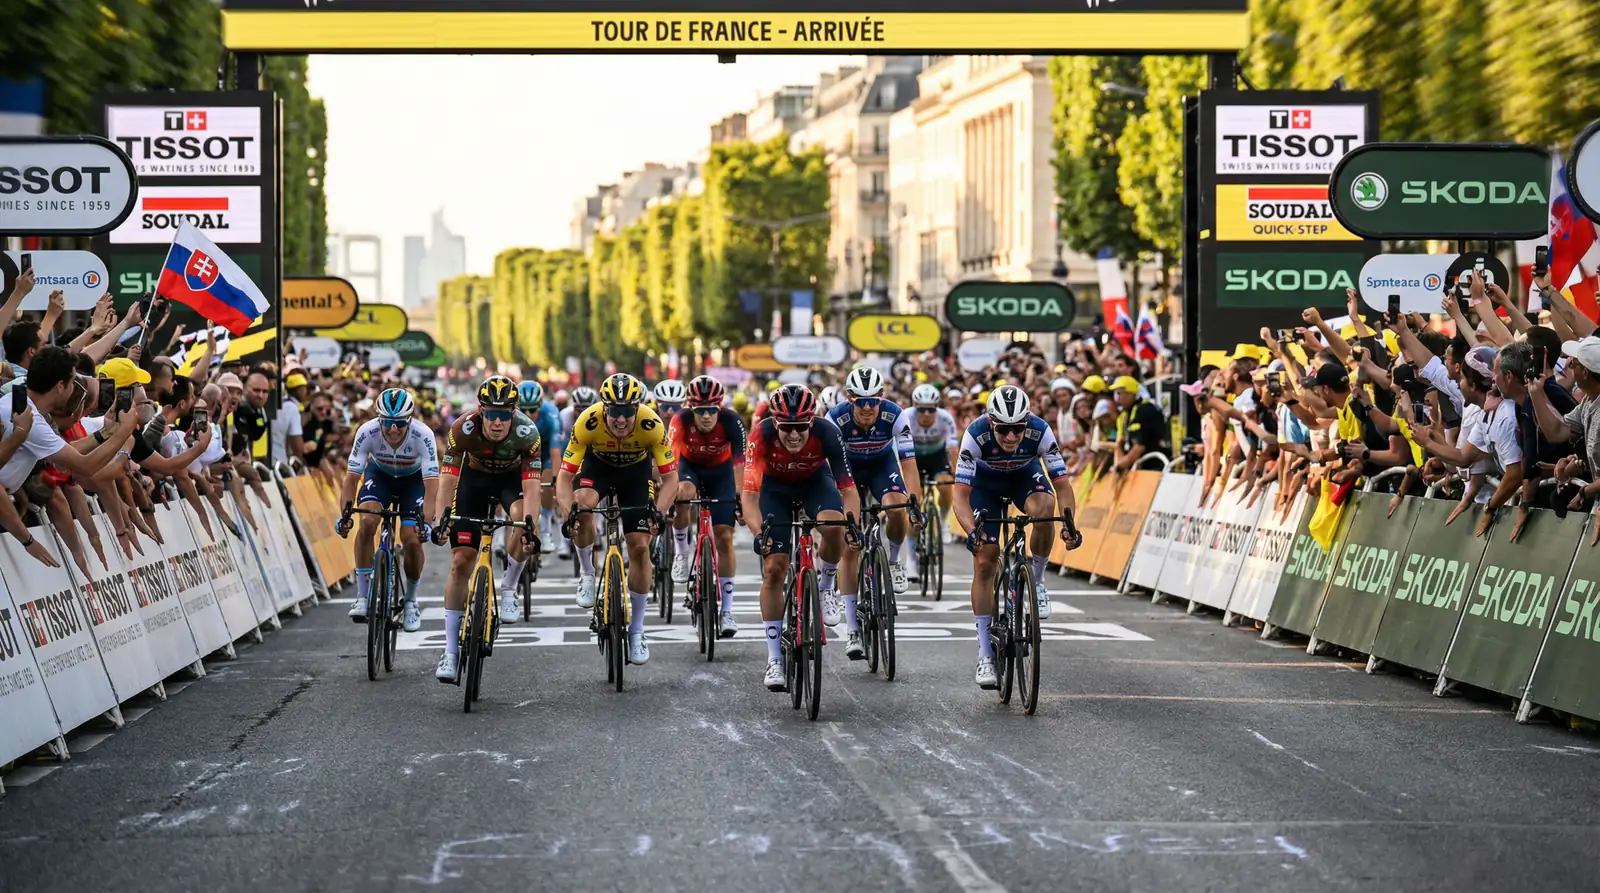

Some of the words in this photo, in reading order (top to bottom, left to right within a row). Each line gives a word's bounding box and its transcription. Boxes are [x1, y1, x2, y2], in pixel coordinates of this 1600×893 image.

[591, 20, 649, 41] TOUR
[655, 20, 682, 41] DE
[689, 20, 772, 41] FRANCE
[793, 16, 885, 41] ARRIVÉE
[116, 137, 254, 159] TISSOT
[1223, 135, 1358, 157] TISSOT
[200, 164, 229, 173] SINCE
[1401, 181, 1547, 204] SKODA
[37, 200, 75, 211] SINCE
[83, 200, 111, 211] 1959
[1248, 203, 1333, 219] SOUDAL
[142, 213, 229, 229] SOUDAL
[1253, 224, 1294, 235] QUICK
[1297, 224, 1328, 235] STEP
[1225, 269, 1357, 291] SKODA
[957, 297, 1063, 316] SKODA
[876, 320, 917, 335] LCL
[1334, 544, 1398, 596] SKODA
[1395, 553, 1470, 611] SKODA
[90, 573, 133, 622] TISSOT
[1469, 565, 1555, 629] SKODA
[34, 589, 83, 642] TISSOT
